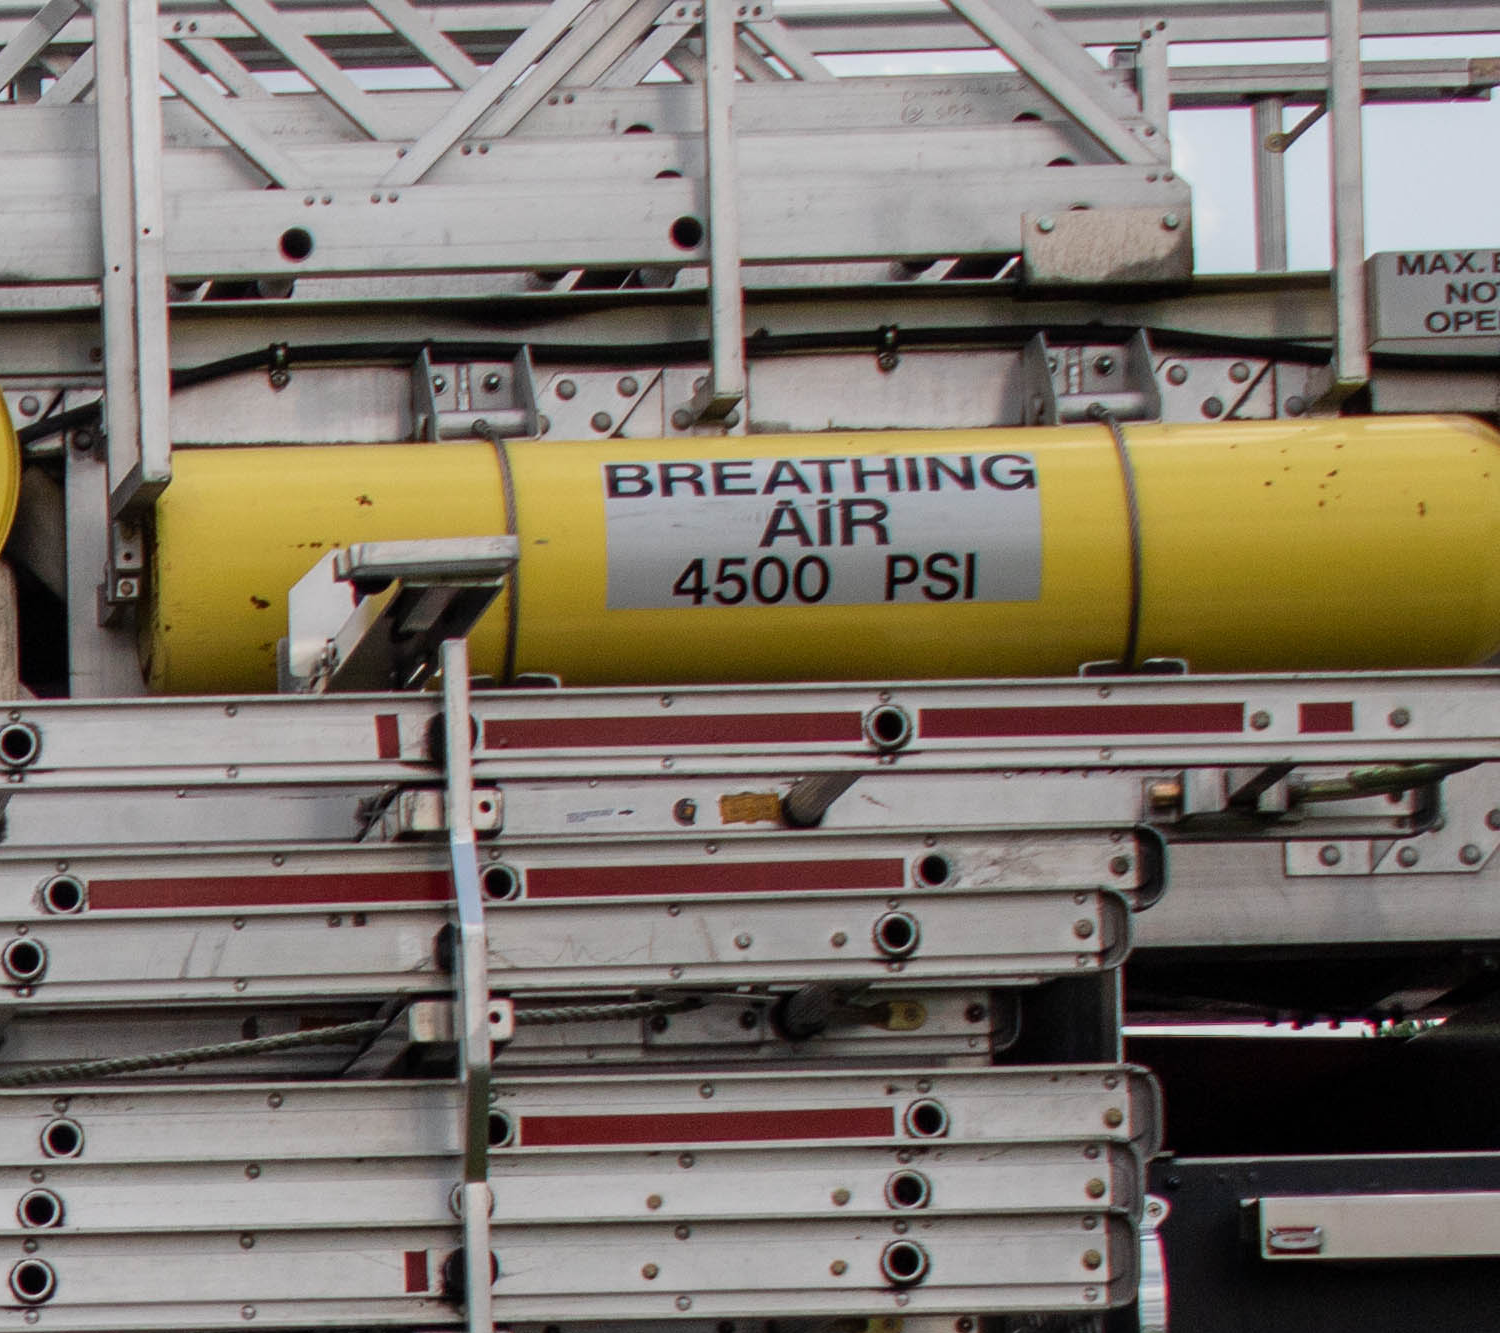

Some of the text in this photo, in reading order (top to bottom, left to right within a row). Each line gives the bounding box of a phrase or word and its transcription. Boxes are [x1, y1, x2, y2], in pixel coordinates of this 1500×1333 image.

[1396, 252, 1485, 276] MAX.
[1424, 310, 1500, 333] OPE
[603, 453, 1037, 499] BREATHING
[759, 498, 890, 548] AIR
[672, 552, 978, 605] 4500 PSI
